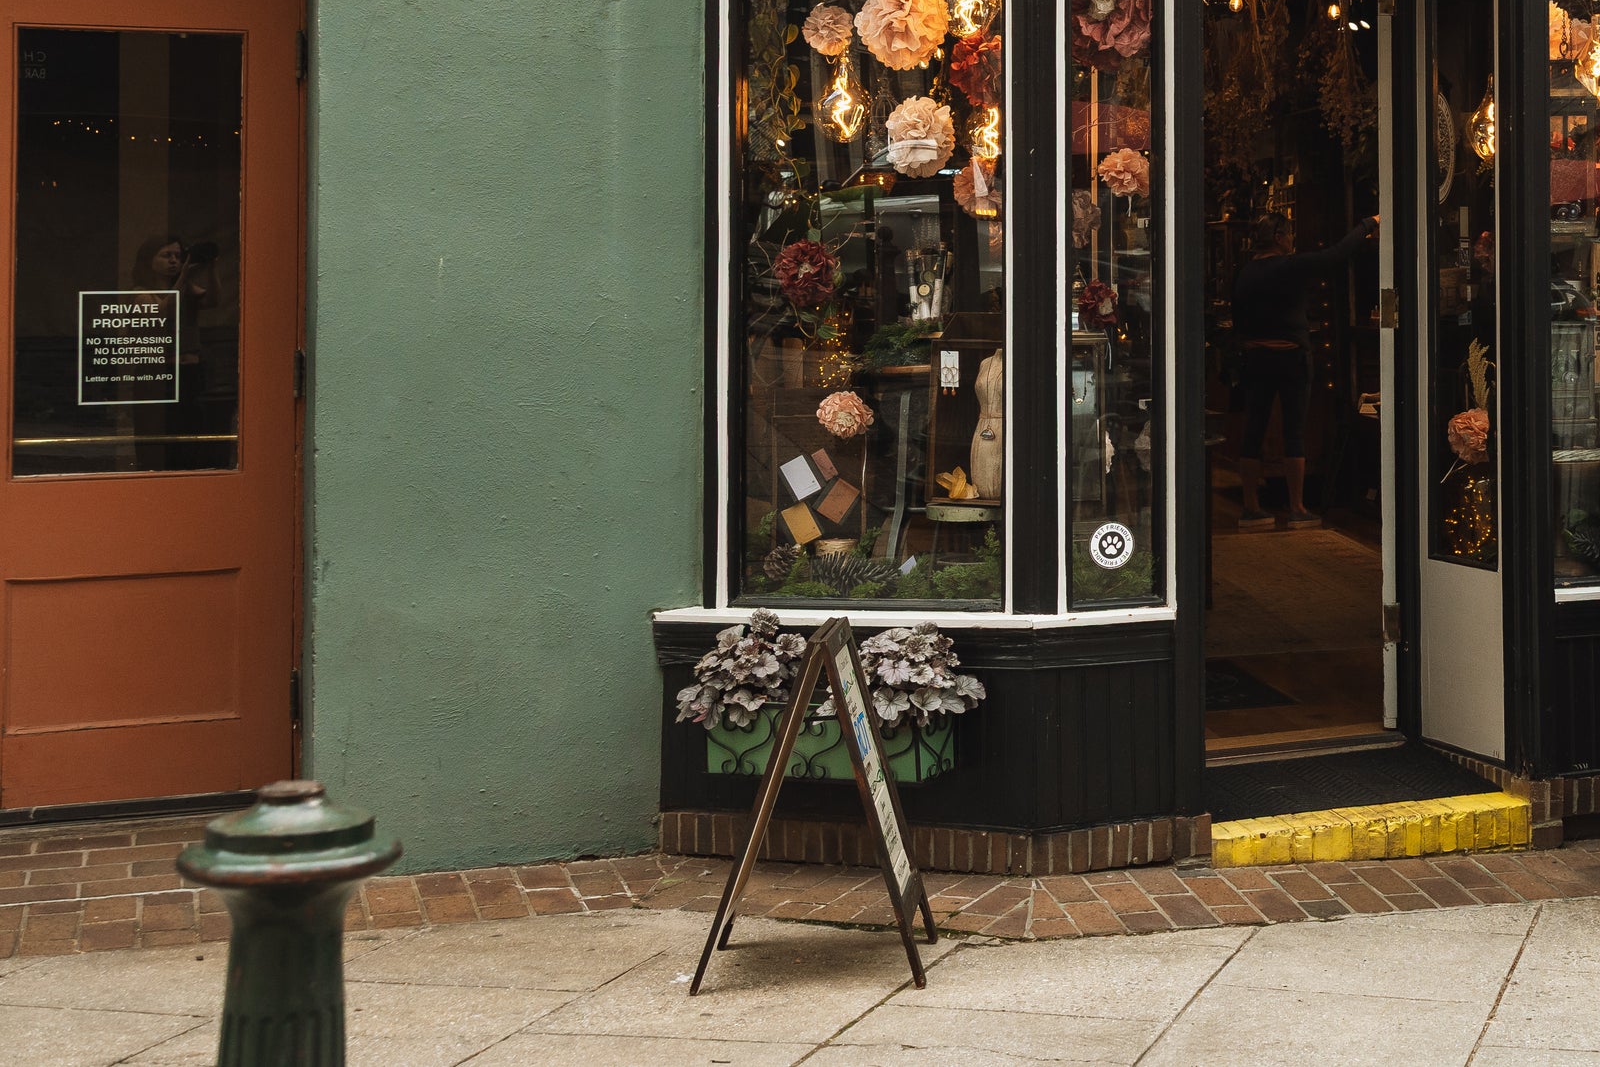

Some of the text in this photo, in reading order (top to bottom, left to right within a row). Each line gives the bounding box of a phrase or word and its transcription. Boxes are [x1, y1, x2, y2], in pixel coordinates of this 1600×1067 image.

[101, 304, 159, 314] PRIVATE
[93, 318, 167, 328] PROPERTY
[104, 337, 173, 345] TRESPASSING
[95, 347, 109, 355] NO
[93, 356, 165, 365] NO SOLICITING
[1095, 525, 1131, 542] PET FRIENDLY
